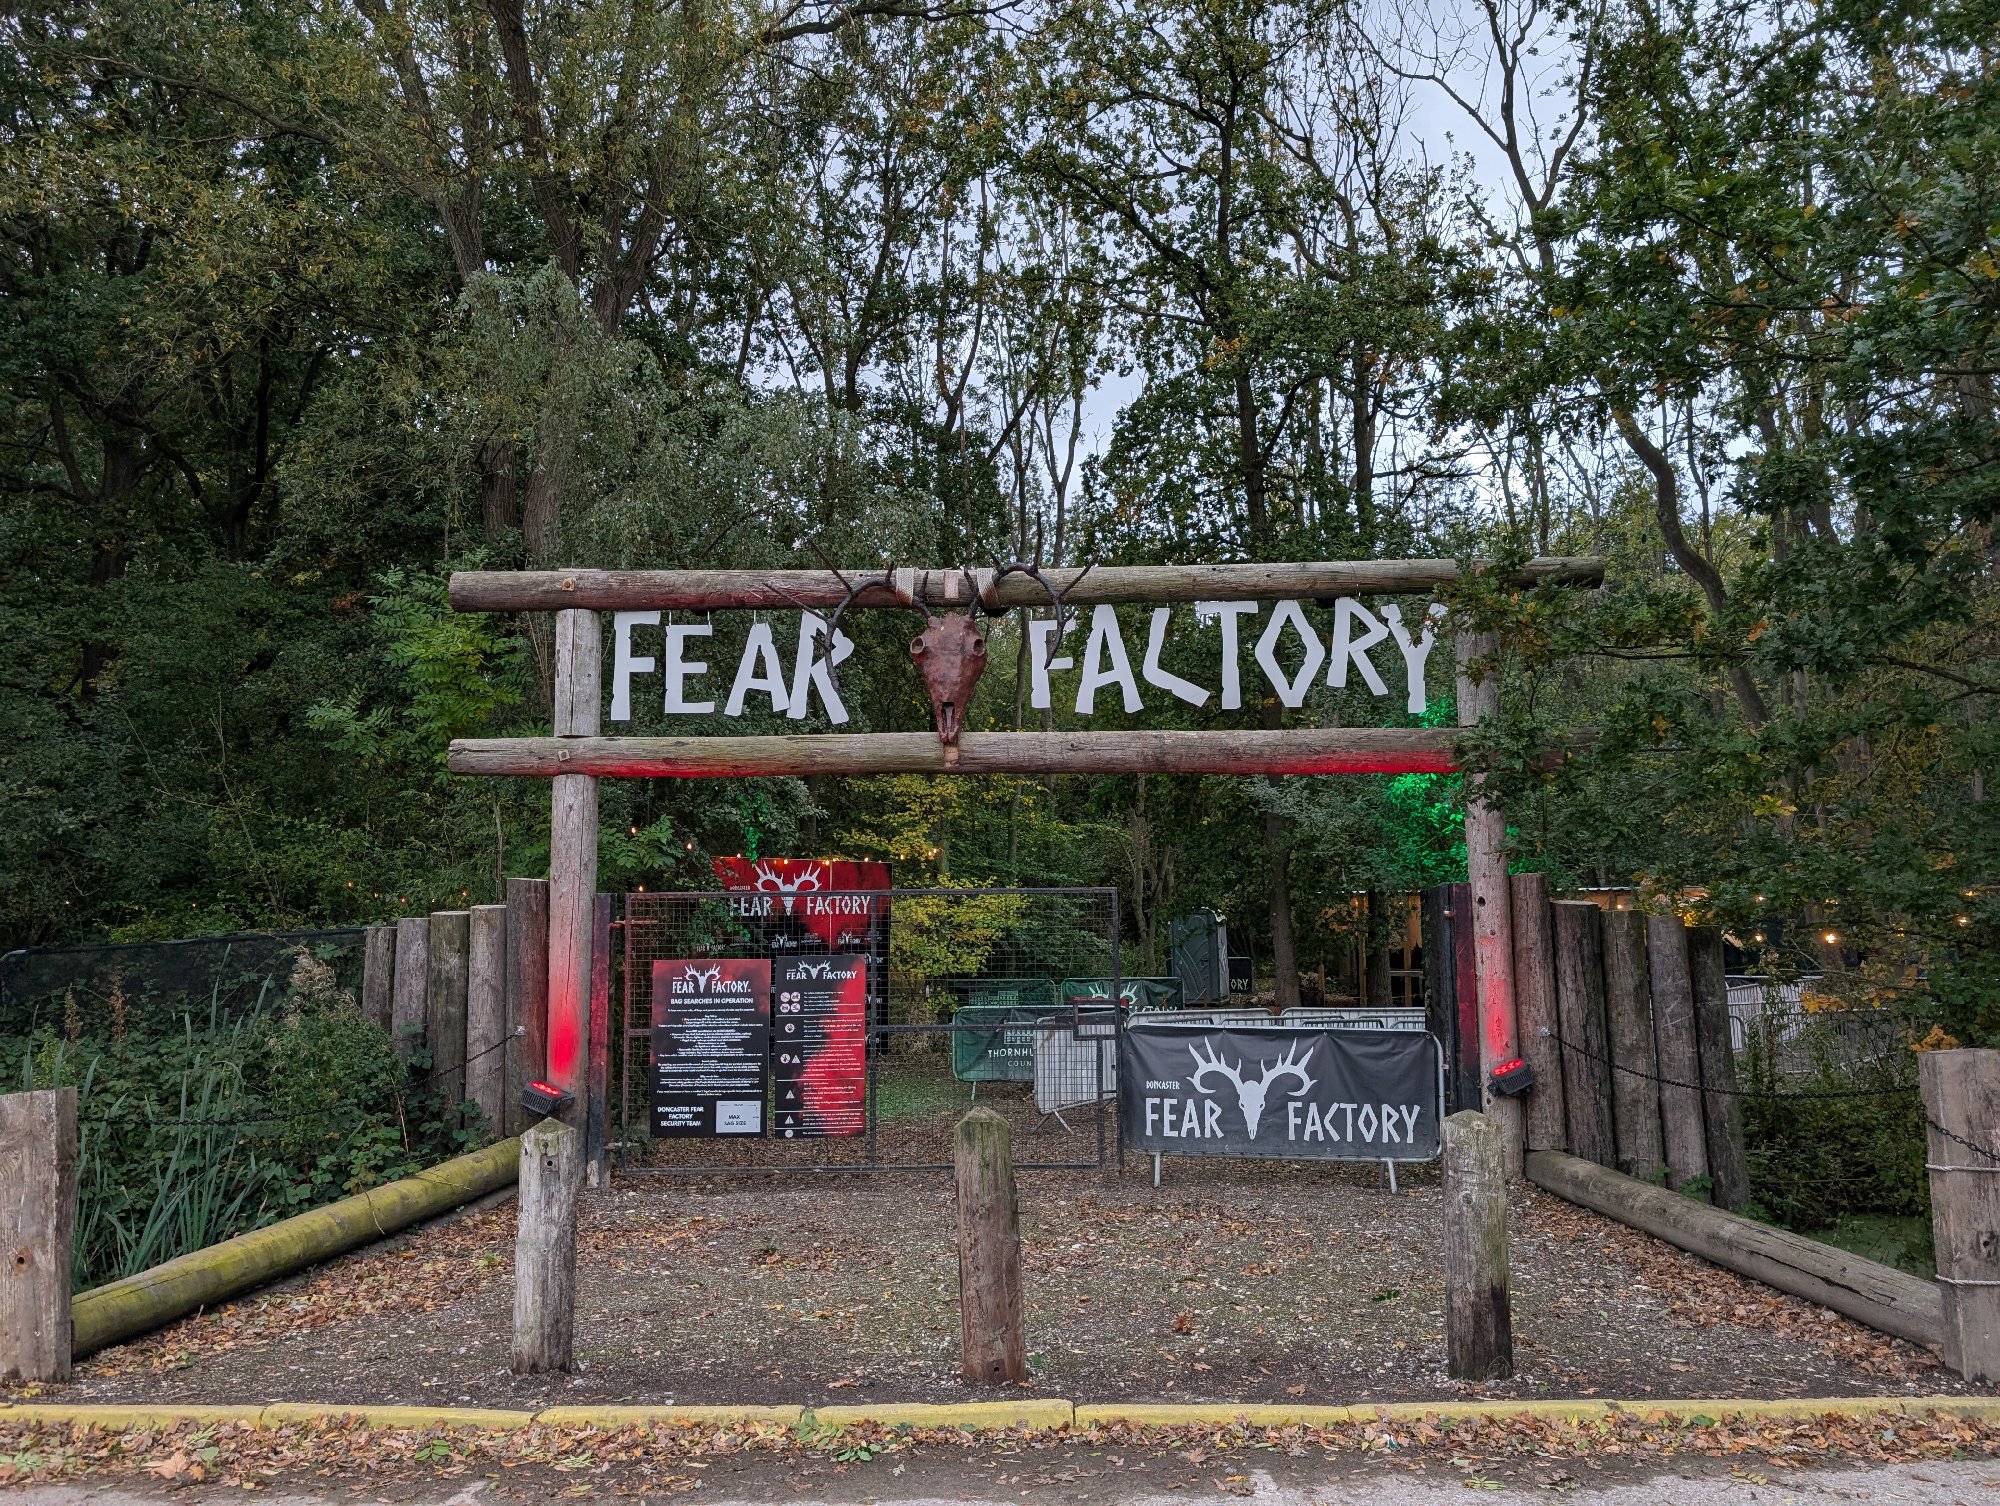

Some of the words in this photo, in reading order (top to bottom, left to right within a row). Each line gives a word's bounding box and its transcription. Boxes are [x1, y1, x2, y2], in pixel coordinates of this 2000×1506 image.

[611, 611, 854, 724] FEAR
[1029, 597, 1448, 714] FACTORY
[730, 896, 773, 916] FEAR
[806, 896, 870, 914] FACTORY
[786, 972, 807, 980] FEAR
[822, 970, 858, 980] FACTORY
[672, 980, 694, 994] FEAR
[712, 980, 750, 994] FACTORY
[1230, 978, 1248, 990] ORY
[1146, 1080, 1180, 1090] DONCASTER
[1146, 1097, 1224, 1138] FEAR
[1288, 1101, 1420, 1144] FACTORY
